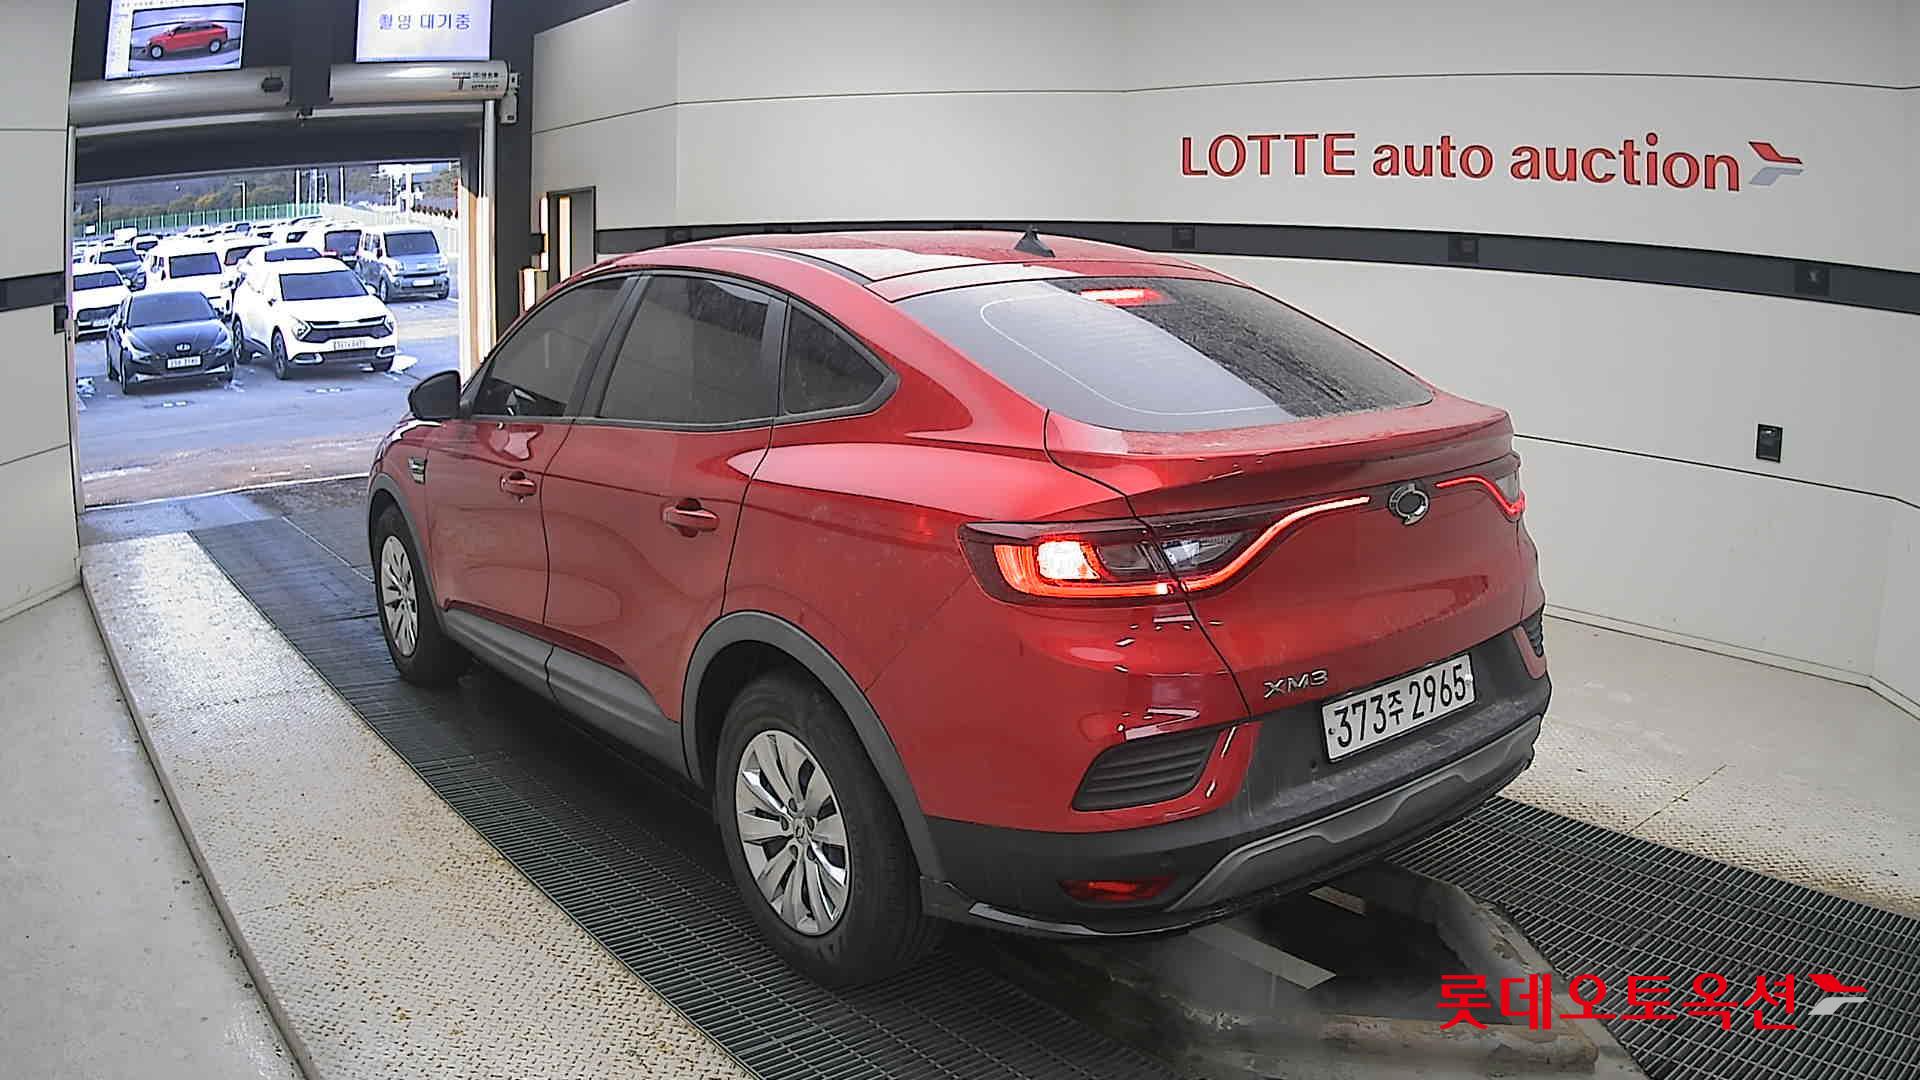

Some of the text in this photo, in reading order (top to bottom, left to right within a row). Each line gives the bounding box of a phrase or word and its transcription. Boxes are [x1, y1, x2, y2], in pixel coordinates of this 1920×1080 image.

[420, 13, 472, 30] 대기중
[1181, 131, 1741, 192] LOTTE auto auction
[1263, 669, 1329, 699] XM3
[1333, 663, 1466, 748] 373주 2965
